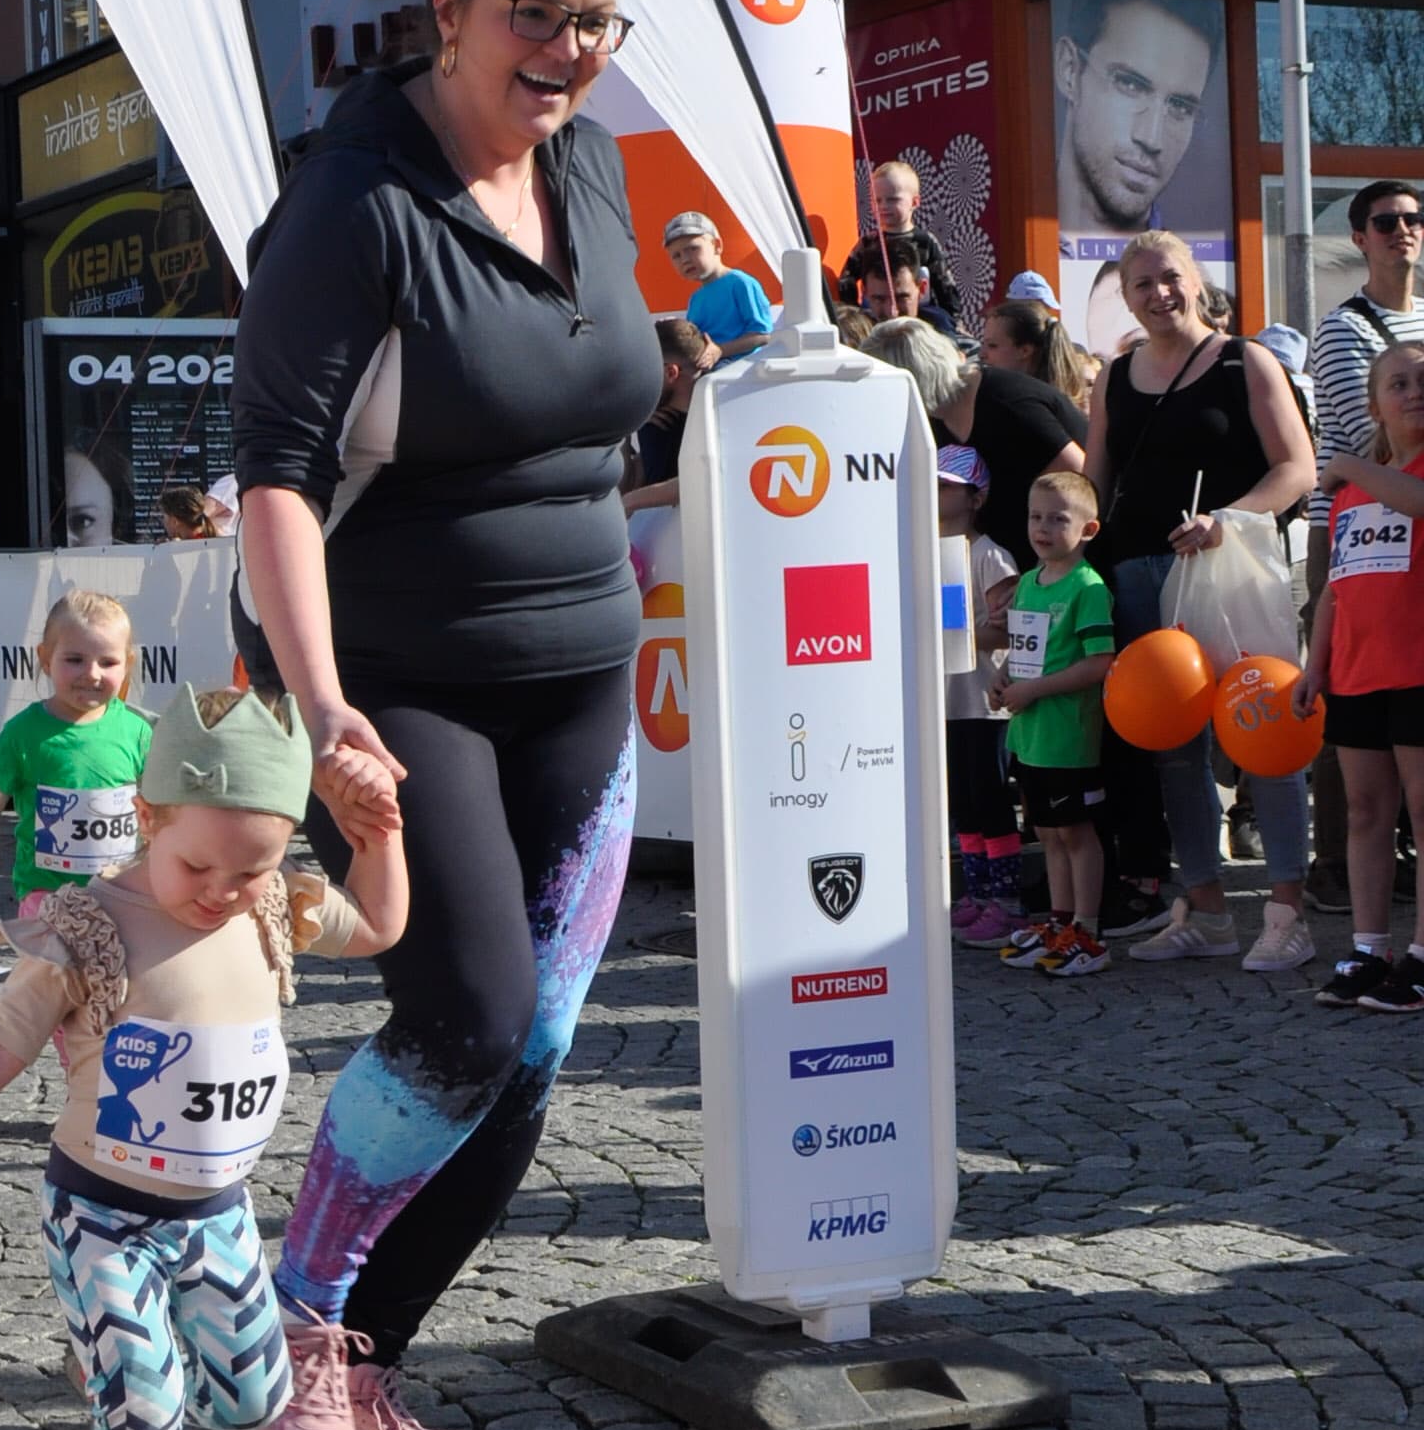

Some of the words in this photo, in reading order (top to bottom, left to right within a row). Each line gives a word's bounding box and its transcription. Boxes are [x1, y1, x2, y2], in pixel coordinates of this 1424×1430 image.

[874, 37, 941, 66] OPTIKA
[69, 355, 135, 385] 04
[844, 453, 895, 482] NN
[1349, 524, 1408, 548] 3042
[795, 635, 862, 657] AVON
[142, 646, 177, 683] NN
[857, 745, 894, 756] Powered
[857, 759, 868, 769] by
[871, 757, 894, 767] MVM
[769, 791, 828, 809] innogy
[71, 818, 135, 841] 3086
[797, 974, 884, 997] NUTREND
[116, 1036, 157, 1054] KIDS
[114, 1054, 151, 1071] CUP
[180, 1074, 277, 1123] 3187
[826, 1122, 896, 1149] ŠKODA
[807, 1210, 886, 1242] KPMG
